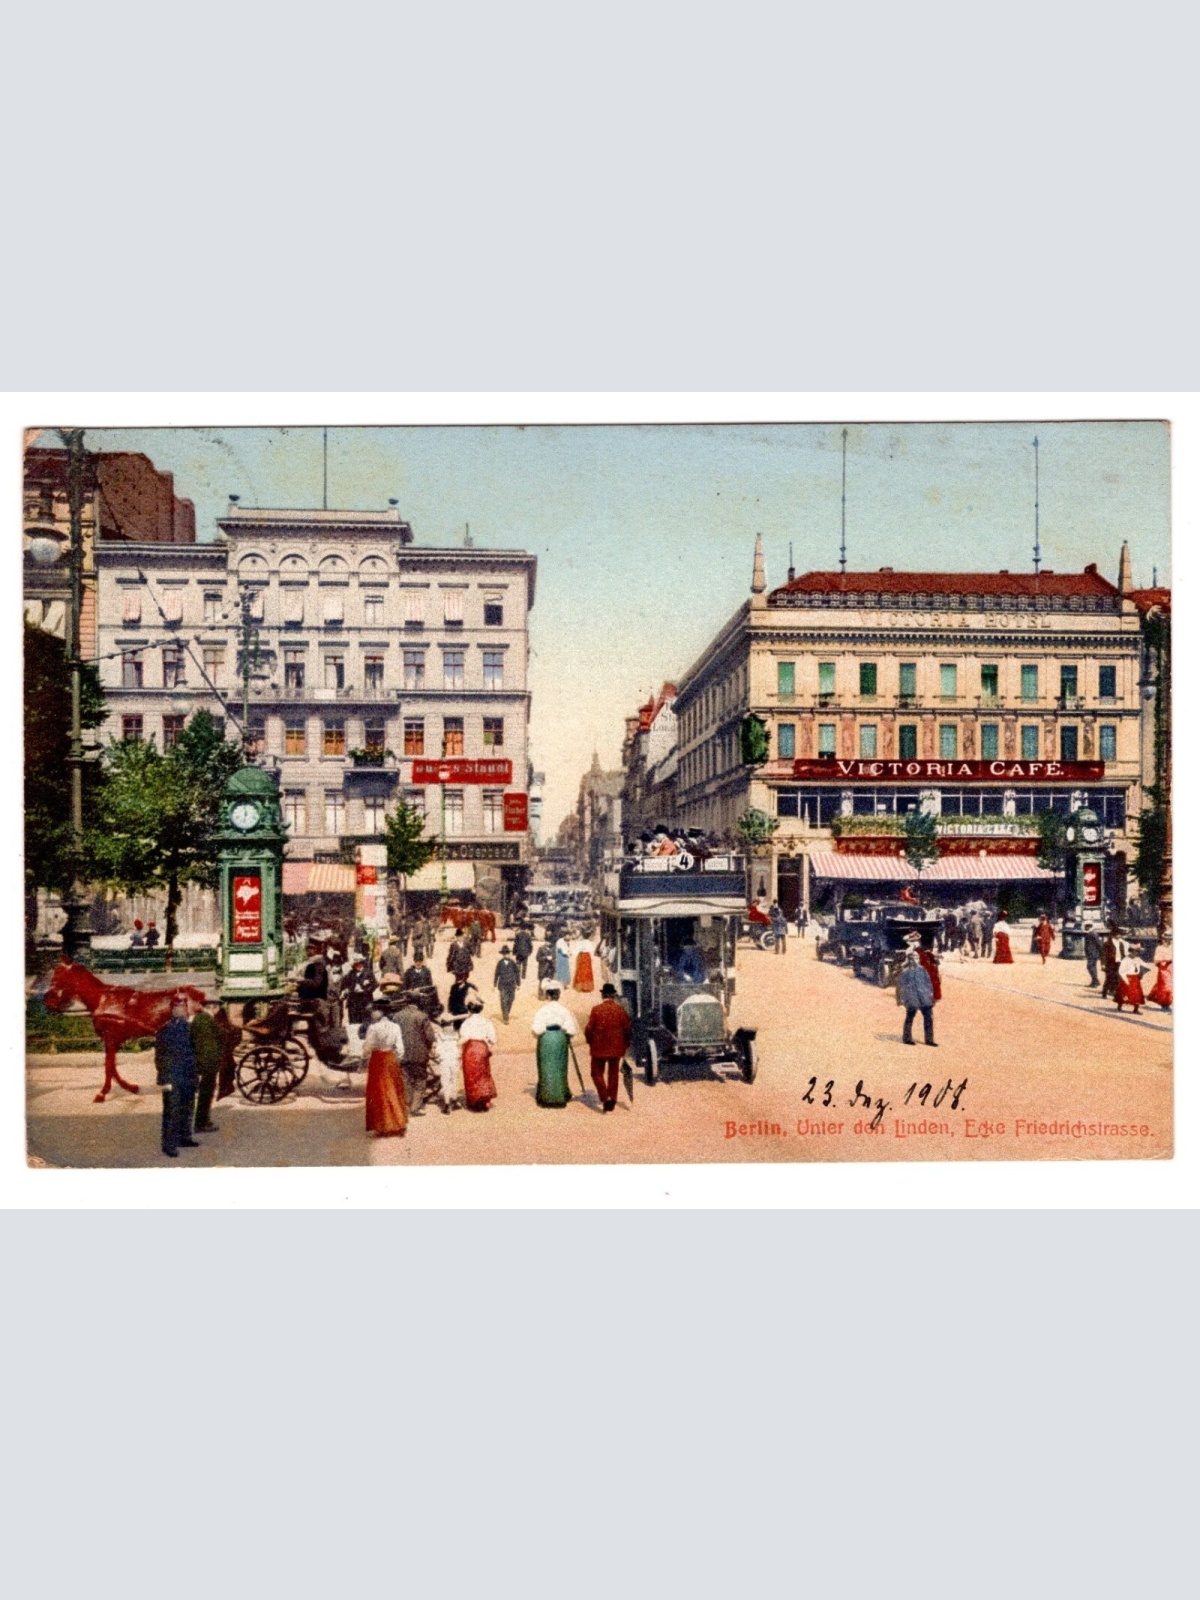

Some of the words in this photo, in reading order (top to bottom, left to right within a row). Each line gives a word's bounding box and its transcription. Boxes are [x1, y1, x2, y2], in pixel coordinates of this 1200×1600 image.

[859, 611, 970, 628] VICTORIA
[985, 612, 1051, 628] HOTEL
[838, 761, 973, 776] VICTORIA
[679, 854, 690, 869] 4
[802, 1076, 836, 1107] 23.
